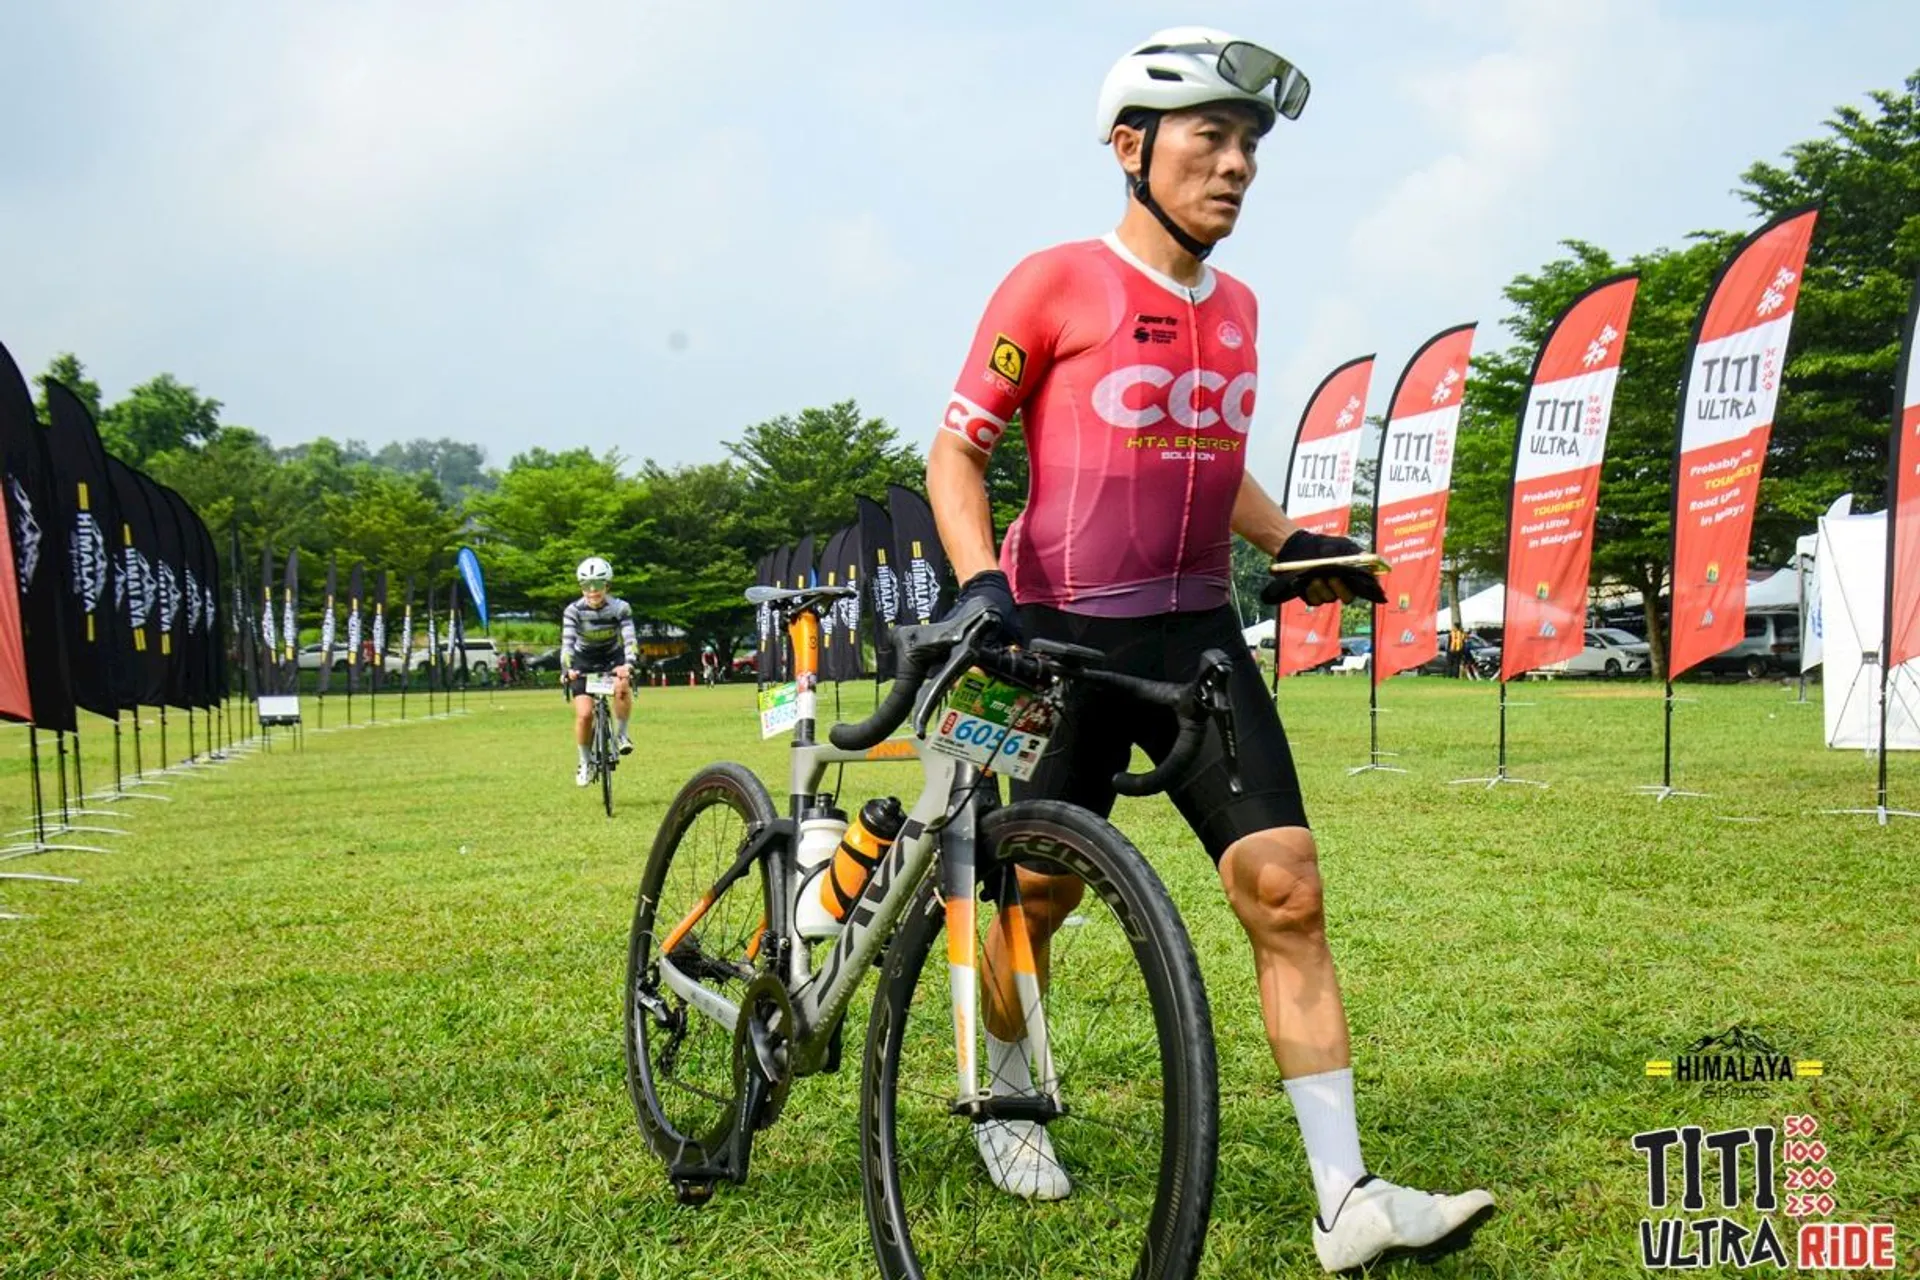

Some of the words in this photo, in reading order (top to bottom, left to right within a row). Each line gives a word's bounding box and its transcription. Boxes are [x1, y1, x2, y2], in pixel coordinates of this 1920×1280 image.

[1702, 354, 1760, 394] TITI
[1535, 398, 1584, 433] TITI
[1698, 396, 1757, 420] ULTRA
[1126, 436, 1169, 449] HTA
[1174, 435, 1240, 452] ENERGY
[1393, 431, 1433, 462] TITI
[1530, 435, 1580, 457] ULTRA
[1300, 453, 1337, 480] TITI
[1389, 464, 1432, 483] ULTRA
[1297, 482, 1336, 500] ULTRA
[76, 512, 97, 613] HIMALAYA
[877, 565, 896, 623] HIMALAYA
[911, 558, 931, 620] HIMALAYA
